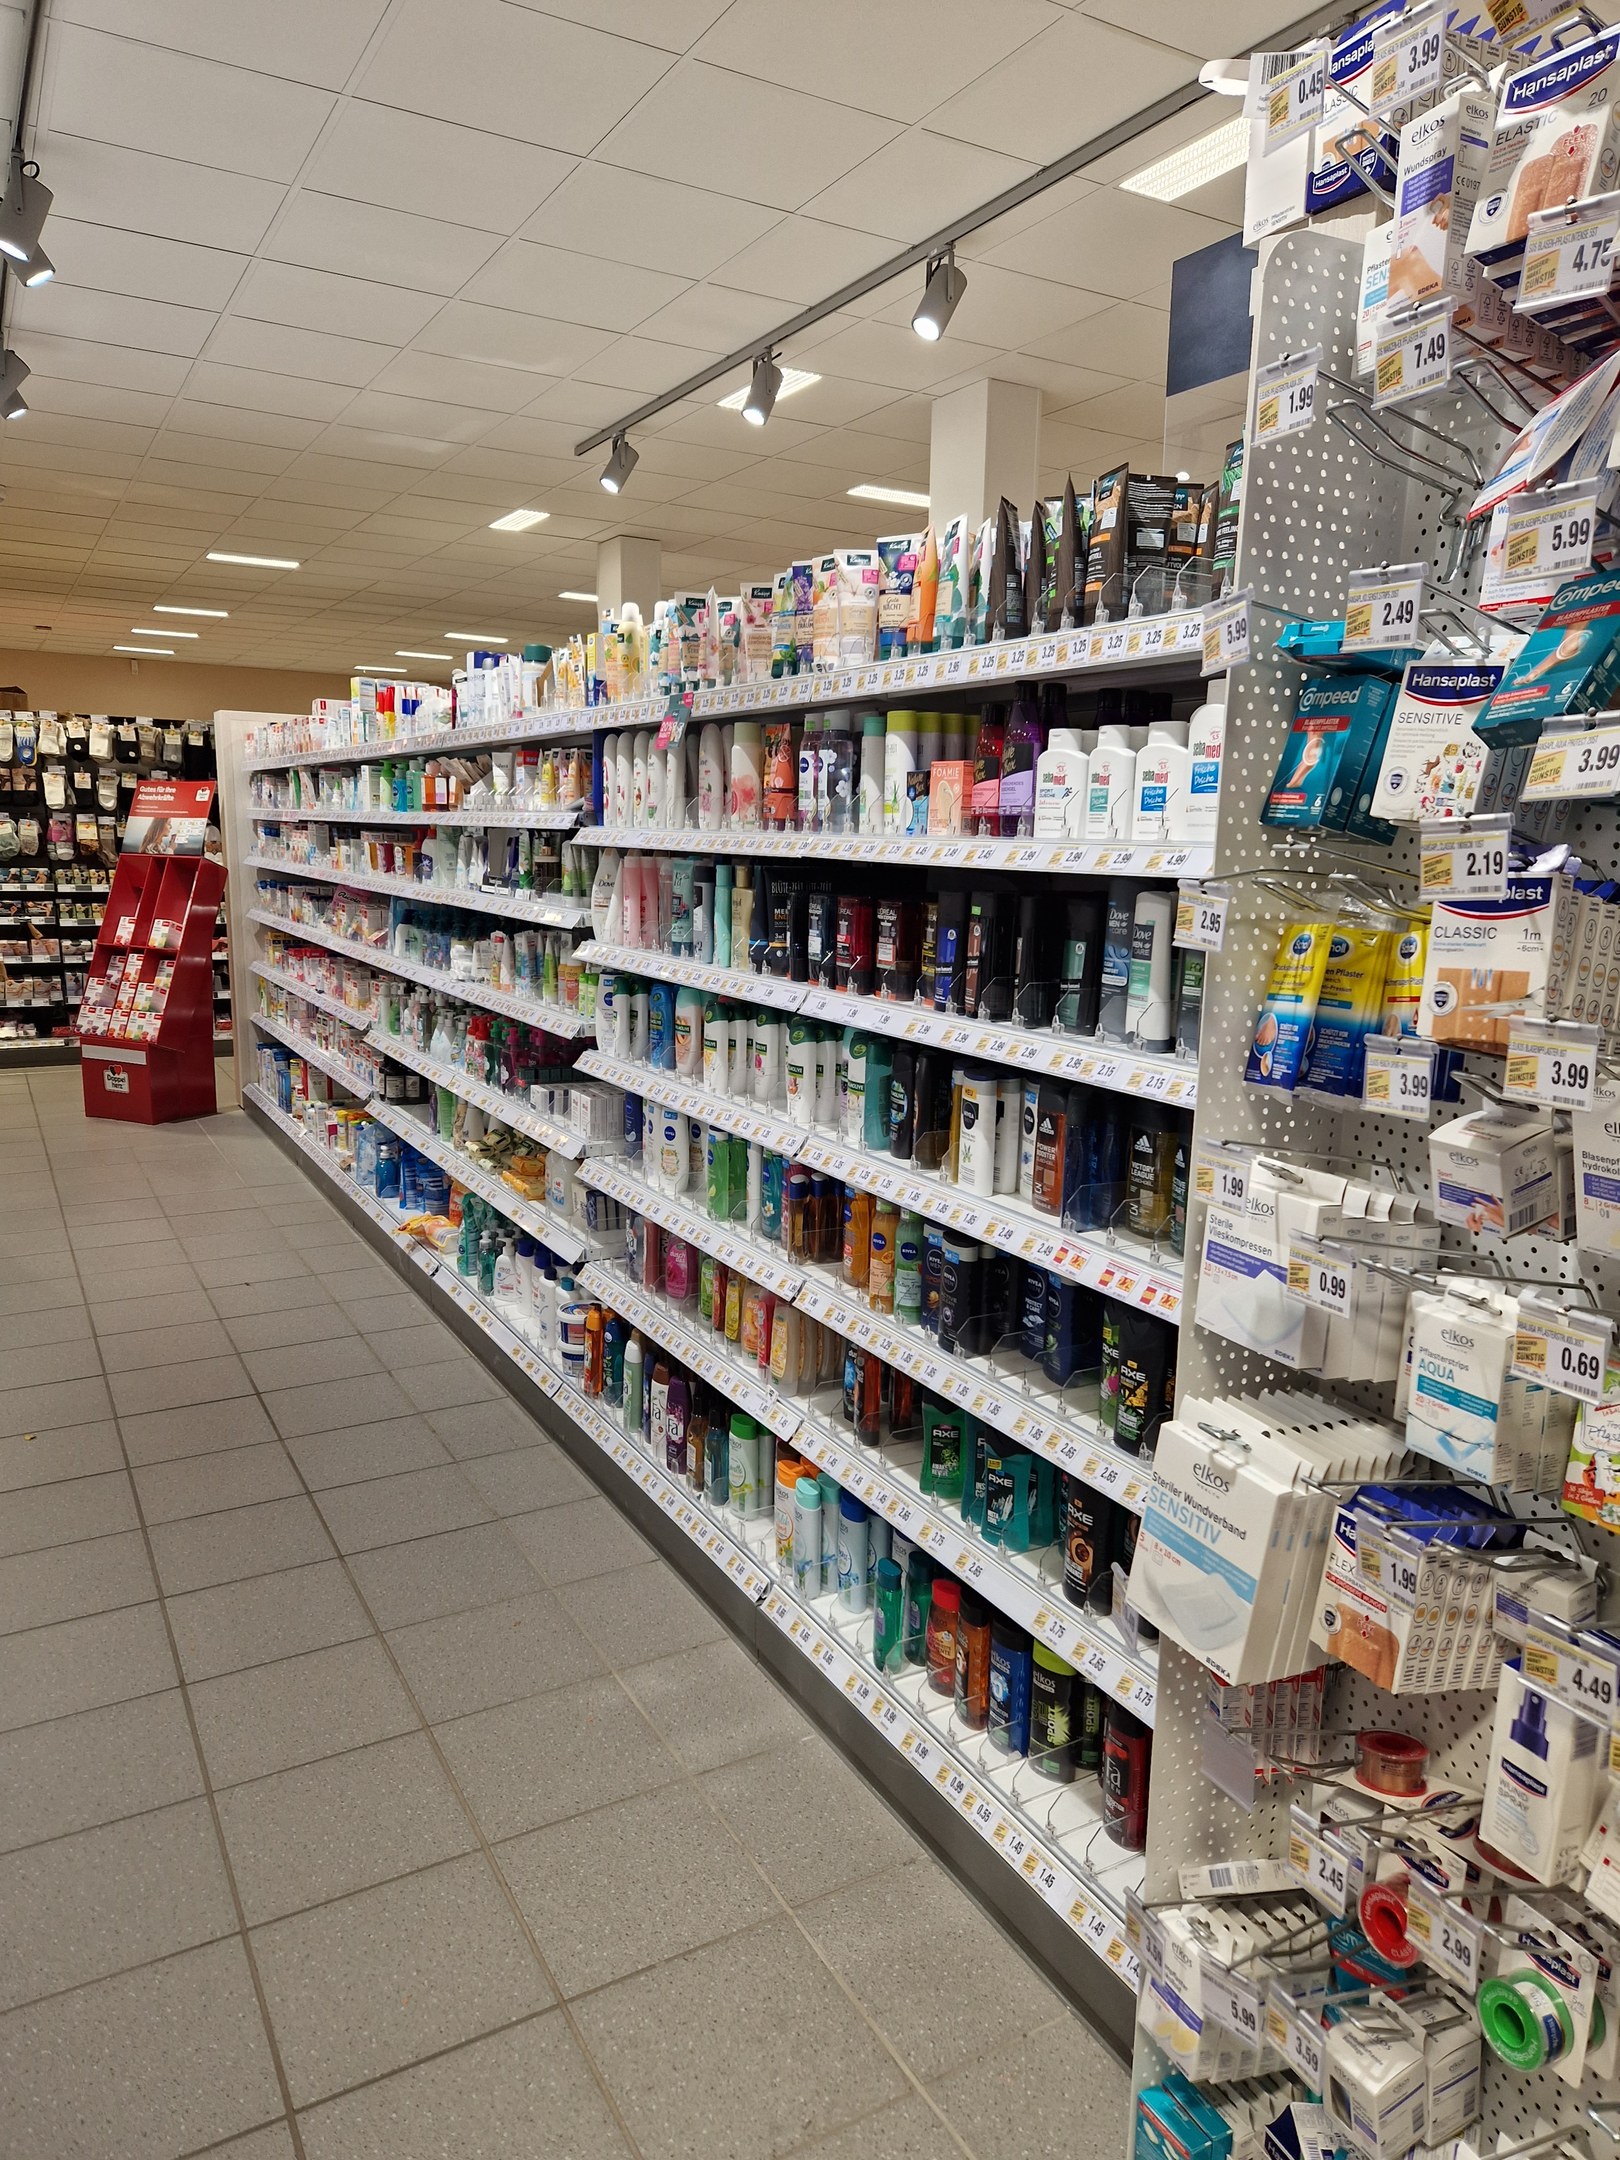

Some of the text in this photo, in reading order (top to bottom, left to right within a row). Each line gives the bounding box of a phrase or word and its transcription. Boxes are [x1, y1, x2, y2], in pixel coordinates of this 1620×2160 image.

[1408, 34, 1440, 74] 3.99
[1512, 44, 1614, 101] Hansaplast
[1299, 70, 1323, 104] 0.45
[1589, 88, 1607, 106] 20
[1466, 105, 1488, 118] elkos
[1411, 115, 1446, 142] elkos
[1496, 110, 1558, 145] ELASTIC
[1403, 147, 1448, 176] Wundspray
[1316, 167, 1348, 188] Hansaplast
[1572, 238, 1614, 272] 4.75
[1414, 333, 1445, 369] 7.49
[1289, 384, 1314, 414] 1.99
[1552, 518, 1590, 552] 5.99
[1382, 600, 1414, 626] 2.49
[1146, 630, 1162, 646] 3.25
[1183, 624, 1200, 640] 3.25
[1227, 617, 1246, 646] 5.99
[1073, 639, 1087, 654] 3.25
[1108, 634, 1123, 650] 3.25
[1012, 650, 1025, 664] 3.25
[1042, 645, 1055, 660] 3.25
[982, 656, 994, 668] 3.25
[1412, 672, 1496, 690] Hansaplast
[1562, 684, 1571, 694] 6
[1300, 686, 1362, 712] Compeed
[1398, 712, 1463, 726] SENSITIVE
[1193, 743, 1222, 759] sebamed
[1578, 744, 1620, 773] 3.99
[933, 767, 960, 778] FOAMIE
[1142, 770, 1168, 783] sebamed
[1194, 764, 1216, 774] Frische
[1042, 772, 1066, 786] sebamed
[1091, 772, 1110, 785] sebamed
[1144, 787, 1164, 796] Frische
[1314, 796, 1322, 806] 6
[1020, 850, 1035, 861] 2.99
[1066, 852, 1082, 862] 2.99
[1113, 852, 1132, 864] 2.99
[1167, 854, 1185, 866] 4.99
[1467, 852, 1504, 876] 2.19
[1110, 908, 1129, 920] Dove
[1201, 911, 1221, 932] 2.95
[1133, 927, 1152, 940] Dove
[1434, 926, 1542, 940] CLASSIC 1m
[1332, 970, 1364, 980] Pflaster
[990, 1040, 1005, 1051] 2.99
[1021, 1047, 1038, 1059] 2.99
[1066, 1057, 1082, 1070] 2.95
[1100, 1064, 1115, 1077] 2.15
[107, 1074, 126, 1082] Doppel
[1146, 1076, 1165, 1090] 2.15
[1552, 1060, 1588, 1090] 3.99
[1400, 1074, 1428, 1098] 3.99
[1039, 1126, 1054, 1136] adidas
[1036, 1150, 1056, 1161] BOOSTER
[1037, 1143, 1056, 1154] POWER
[1134, 1144, 1154, 1154] adidas
[1449, 1151, 1479, 1166] elkos
[1130, 1169, 1155, 1181] LEAGUE
[1132, 1162, 1156, 1174] VICTORY
[1222, 1174, 1244, 1198] 1.99
[936, 1202, 948, 1214] 1.85
[964, 1213, 978, 1226] 1.85
[1210, 1214, 1234, 1230] Sterile
[998, 1226, 1014, 1240] 2.49
[1208, 1224, 1272, 1256] Vlieskompressen
[873, 1238, 886, 1246] NIVEA
[1038, 1242, 1053, 1256] 2.49
[1028, 1276, 1044, 1287] NIVEA
[1320, 1272, 1346, 1299] 0.99
[1026, 1297, 1044, 1308] PROTECT
[1440, 1328, 1474, 1348] elkos
[901, 1351, 912, 1364] 1.85
[1103, 1343, 1120, 1359] AXE
[1274, 1349, 1296, 1362] EDEKA
[1419, 1346, 1469, 1372] Pflasterstrips
[924, 1365, 938, 1378] 1.85
[1418, 1358, 1455, 1382] AQUA
[1561, 1348, 1600, 1381] 0.69
[1121, 1365, 1146, 1382] AXE
[956, 1382, 968, 1397] 1.85
[652, 1402, 662, 1420] Fa
[987, 1401, 1002, 1416] 1.85
[668, 1418, 678, 1436] Fa
[932, 1429, 960, 1438] AXE
[1028, 1424, 1044, 1440] 1.85
[1060, 1443, 1076, 1460] 2.65
[852, 1472, 864, 1486] 1.45
[988, 1474, 1014, 1488] AXE
[1100, 1466, 1118, 1483] 2.65
[1192, 1462, 1230, 1494] elkos
[1466, 1466, 1488, 1480] EDEKA
[875, 1490, 888, 1504] 1.45
[1152, 1472, 1247, 1541] Steriler Wundverband
[898, 1508, 911, 1522] 2.65
[1068, 1506, 1094, 1525] AXE
[1148, 1486, 1222, 1545] SENSITIV
[931, 1532, 945, 1546] 3.75
[968, 1560, 984, 1578] 2.65
[1391, 1562, 1417, 1592] 1.99
[1049, 1620, 1066, 1640] 3.75
[1088, 1653, 1106, 1672] 2.65
[1206, 1656, 1232, 1680] EDEKA
[1572, 1669, 1612, 1704] 4.49
[1134, 1688, 1154, 1707] 3.75
[1047, 1704, 1056, 1744] SPORT
[1086, 1699, 1094, 1733] SPORT
[914, 1741, 928, 1760] 0.99
[1106, 1756, 1122, 1788] Fa
[1503, 1760, 1547, 1796] Hansaplast
[950, 1774, 965, 1794] 0.99
[1500, 1777, 1529, 1802] WUND
[1498, 1788, 1530, 1812] SPRAY
[976, 1802, 992, 1824] 0.55
[1008, 1836, 1024, 1855] 1.45
[1039, 1868, 1056, 1888] 1.45
[1319, 1858, 1344, 1892] 2.45
[1088, 1915, 1106, 1937] 1.45
[1172, 1942, 1193, 1968] elkos
[1442, 1929, 1470, 1967] 2.99
[1230, 2001, 1256, 2031] 5.99
[1296, 2036, 1318, 2072] 3.59
